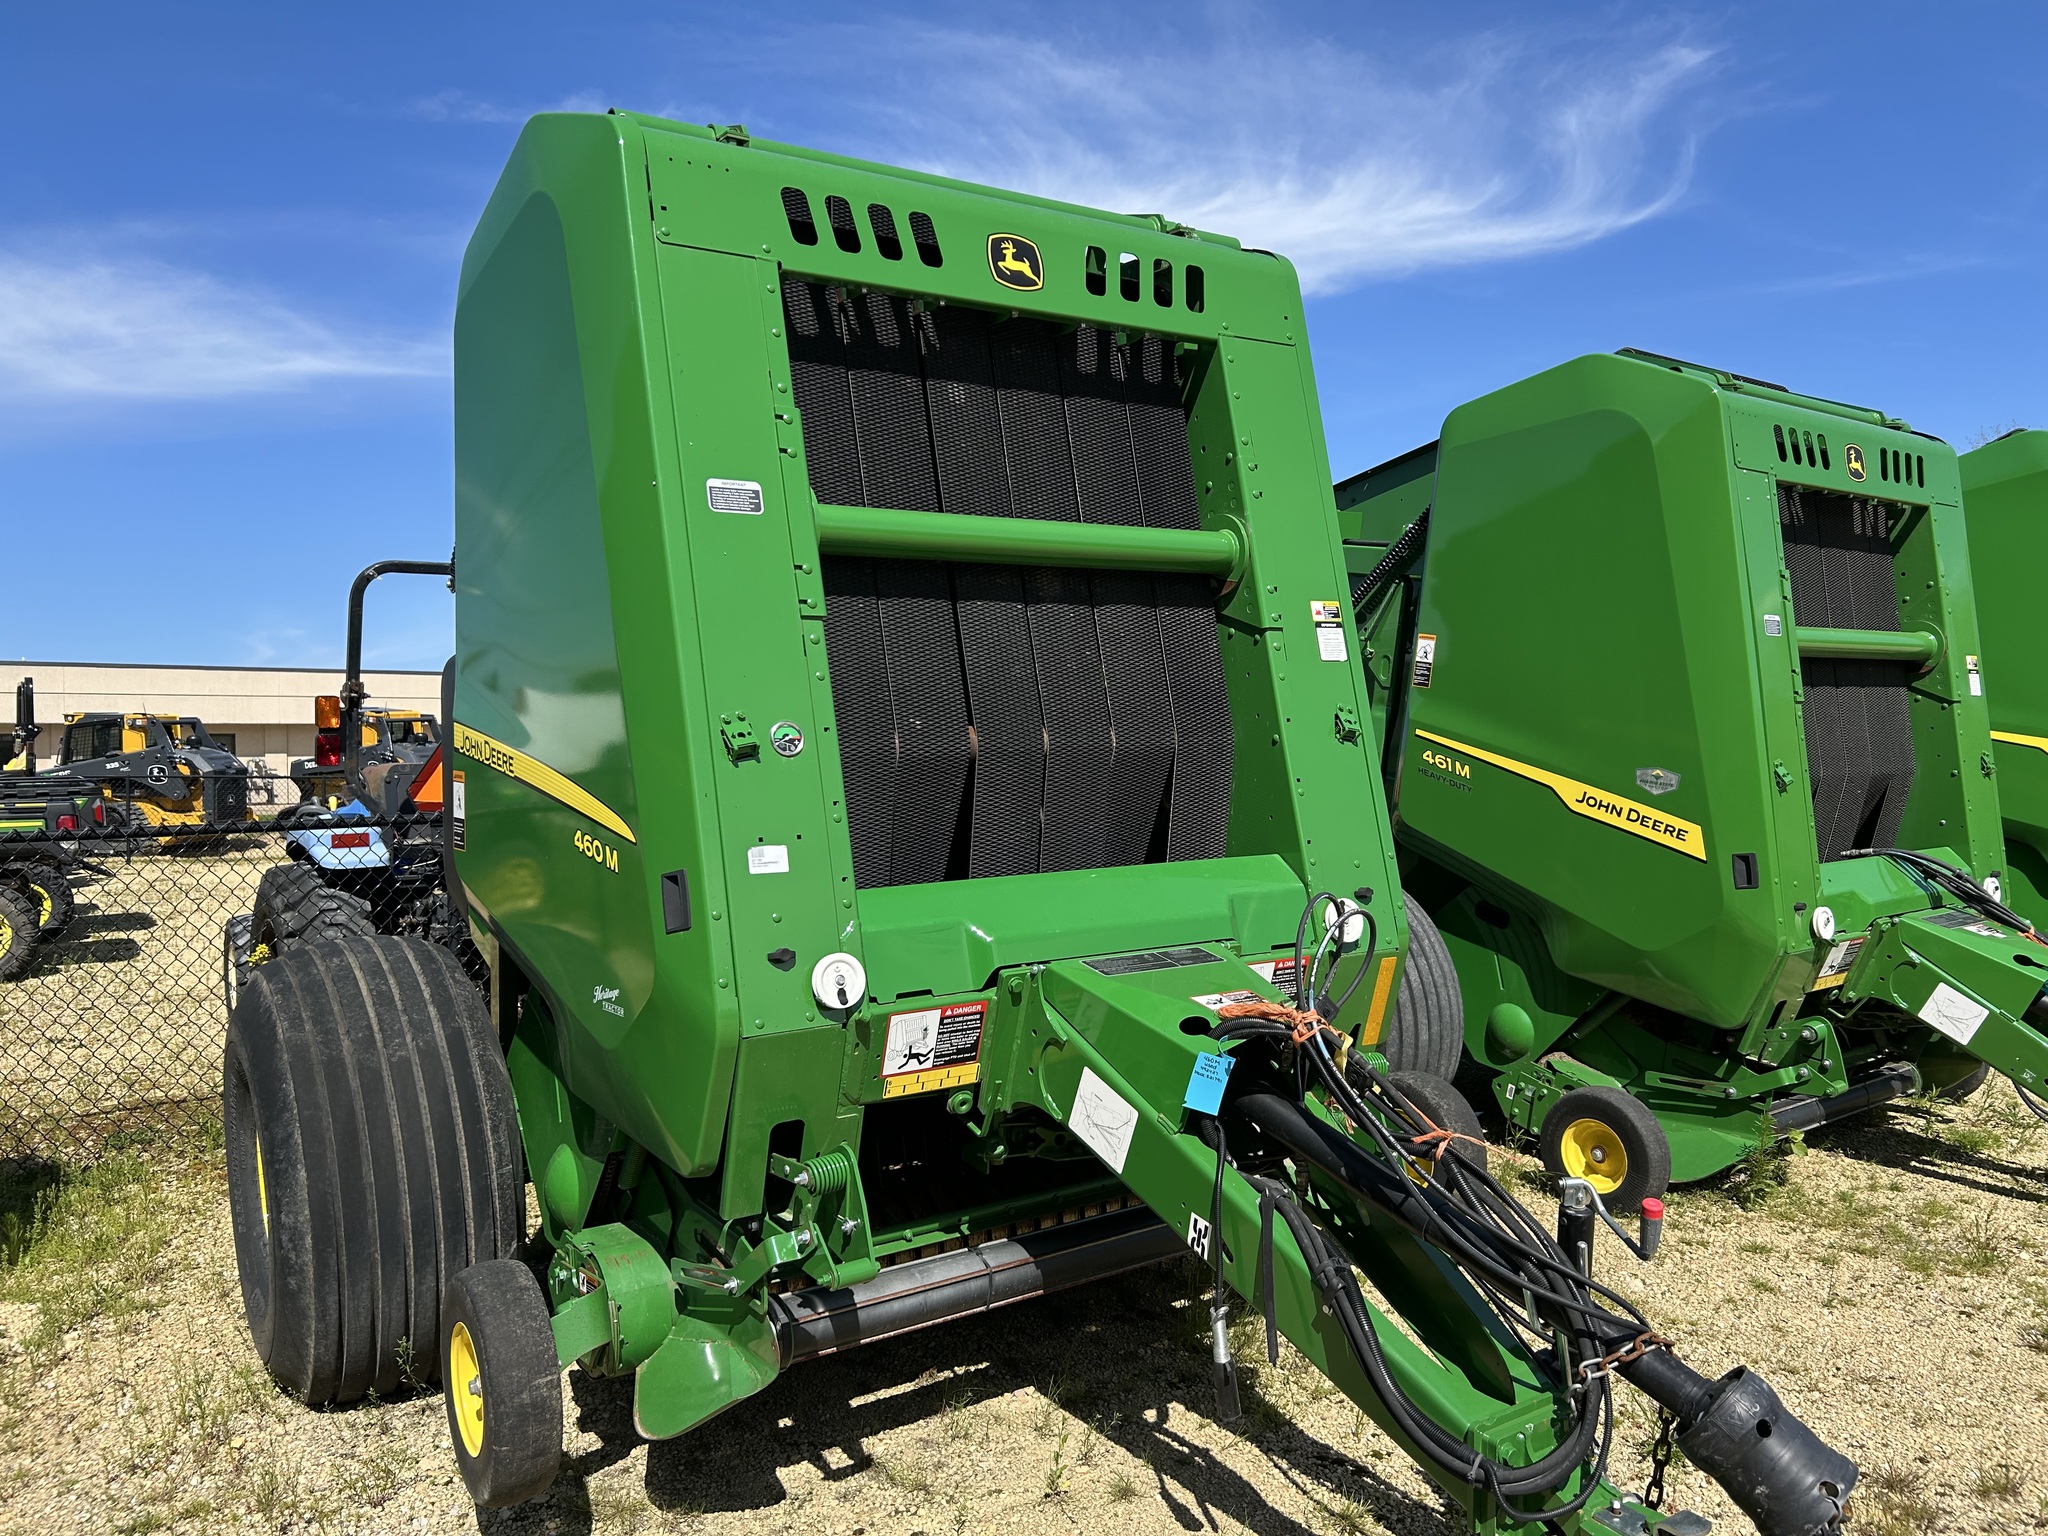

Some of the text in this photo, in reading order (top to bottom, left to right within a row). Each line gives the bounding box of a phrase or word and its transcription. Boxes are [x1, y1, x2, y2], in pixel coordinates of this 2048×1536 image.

[460, 731, 515, 774] JOHN DEERE
[1422, 749, 1471, 780] 461 M
[1418, 767, 1472, 793] HEAVY-DUTY
[1575, 791, 1689, 842] JOHN DEERE
[573, 828, 619, 874] 460 M
[592, 984, 620, 1003] Heritage
[602, 1001, 624, 1017] TRACTOR
[953, 1004, 982, 1015] DANGER
